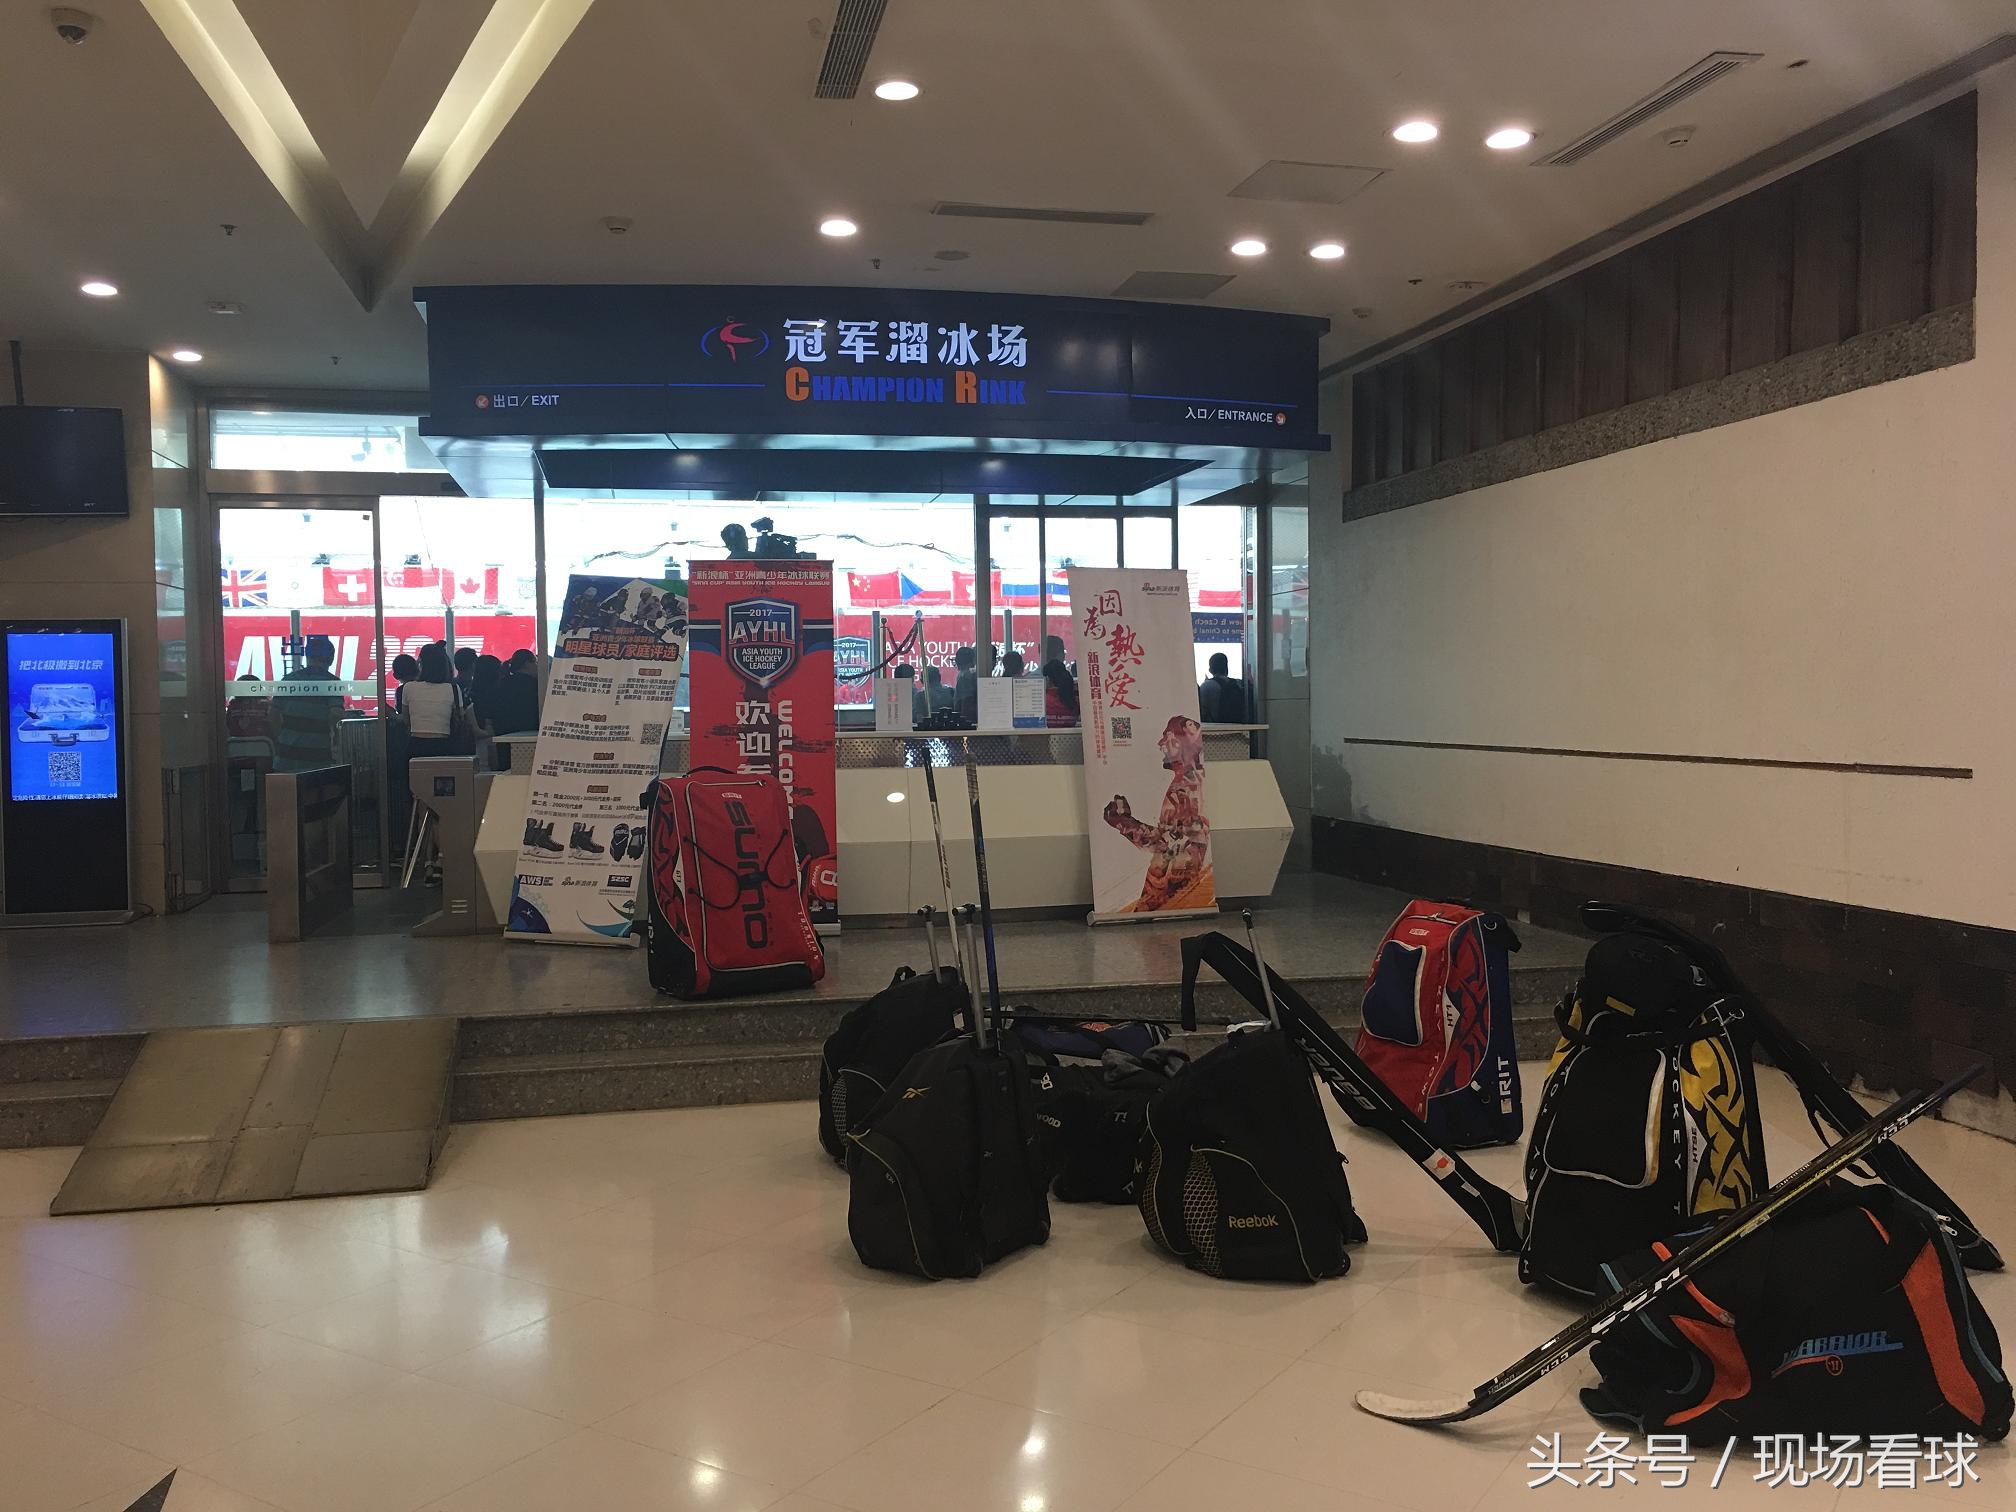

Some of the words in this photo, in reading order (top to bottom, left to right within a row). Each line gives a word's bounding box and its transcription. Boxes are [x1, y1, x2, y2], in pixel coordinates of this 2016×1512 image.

[783, 318, 1028, 368] 冠军溜冰场
[785, 366, 945, 404] CHAMPION
[955, 370, 1026, 405] RINK
[749, 609, 773, 617] 2017
[731, 621, 794, 644] AYHL
[741, 647, 759, 656] ASIA
[759, 647, 783, 656] YOUTH
[742, 655, 755, 663] ICE
[756, 655, 782, 663] HOCKEY
[18, 659, 104, 671] 把北极搬到北京
[749, 662, 776, 670] LEAGUE
[1087, 651, 1102, 700] 新浪体育
[327, 683, 355, 692] rink
[520, 875, 543, 886] AWS
[1294, 1037, 1377, 1110] BAUER
[1497, 1056, 1513, 1115] GRIT
[1671, 1045, 1682, 1170] OCKEY
[1877, 1118, 1909, 1144] CCM
[1228, 1214, 1280, 1229] Reebok
[1590, 1266, 1689, 1336] CCM
[1776, 1331, 1893, 1359] WARRIOR
[1540, 1351, 1570, 1377] CCM
